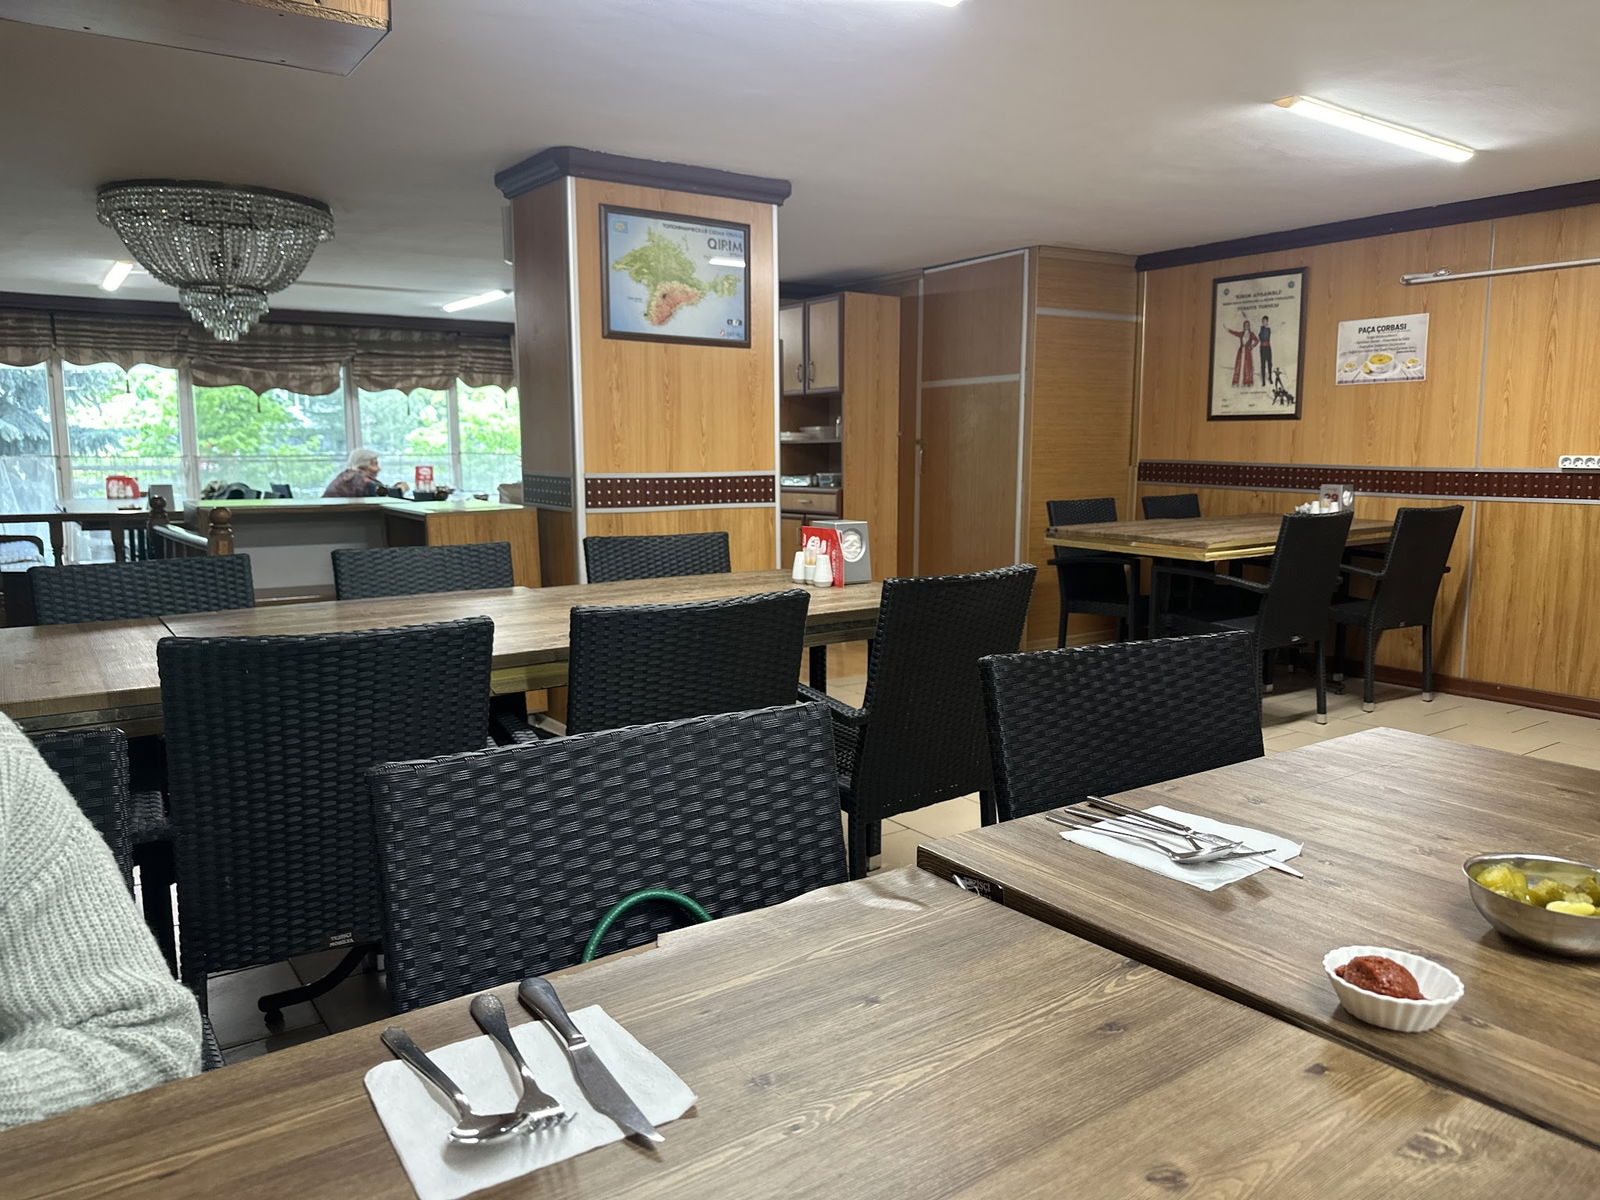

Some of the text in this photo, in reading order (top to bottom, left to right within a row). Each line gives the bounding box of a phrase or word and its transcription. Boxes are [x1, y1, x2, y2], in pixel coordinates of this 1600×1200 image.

[707, 237, 743, 252] QIRIM
[1358, 325, 1376, 335] PAÇA
[1376, 323, 1408, 334] ÇORBASI
